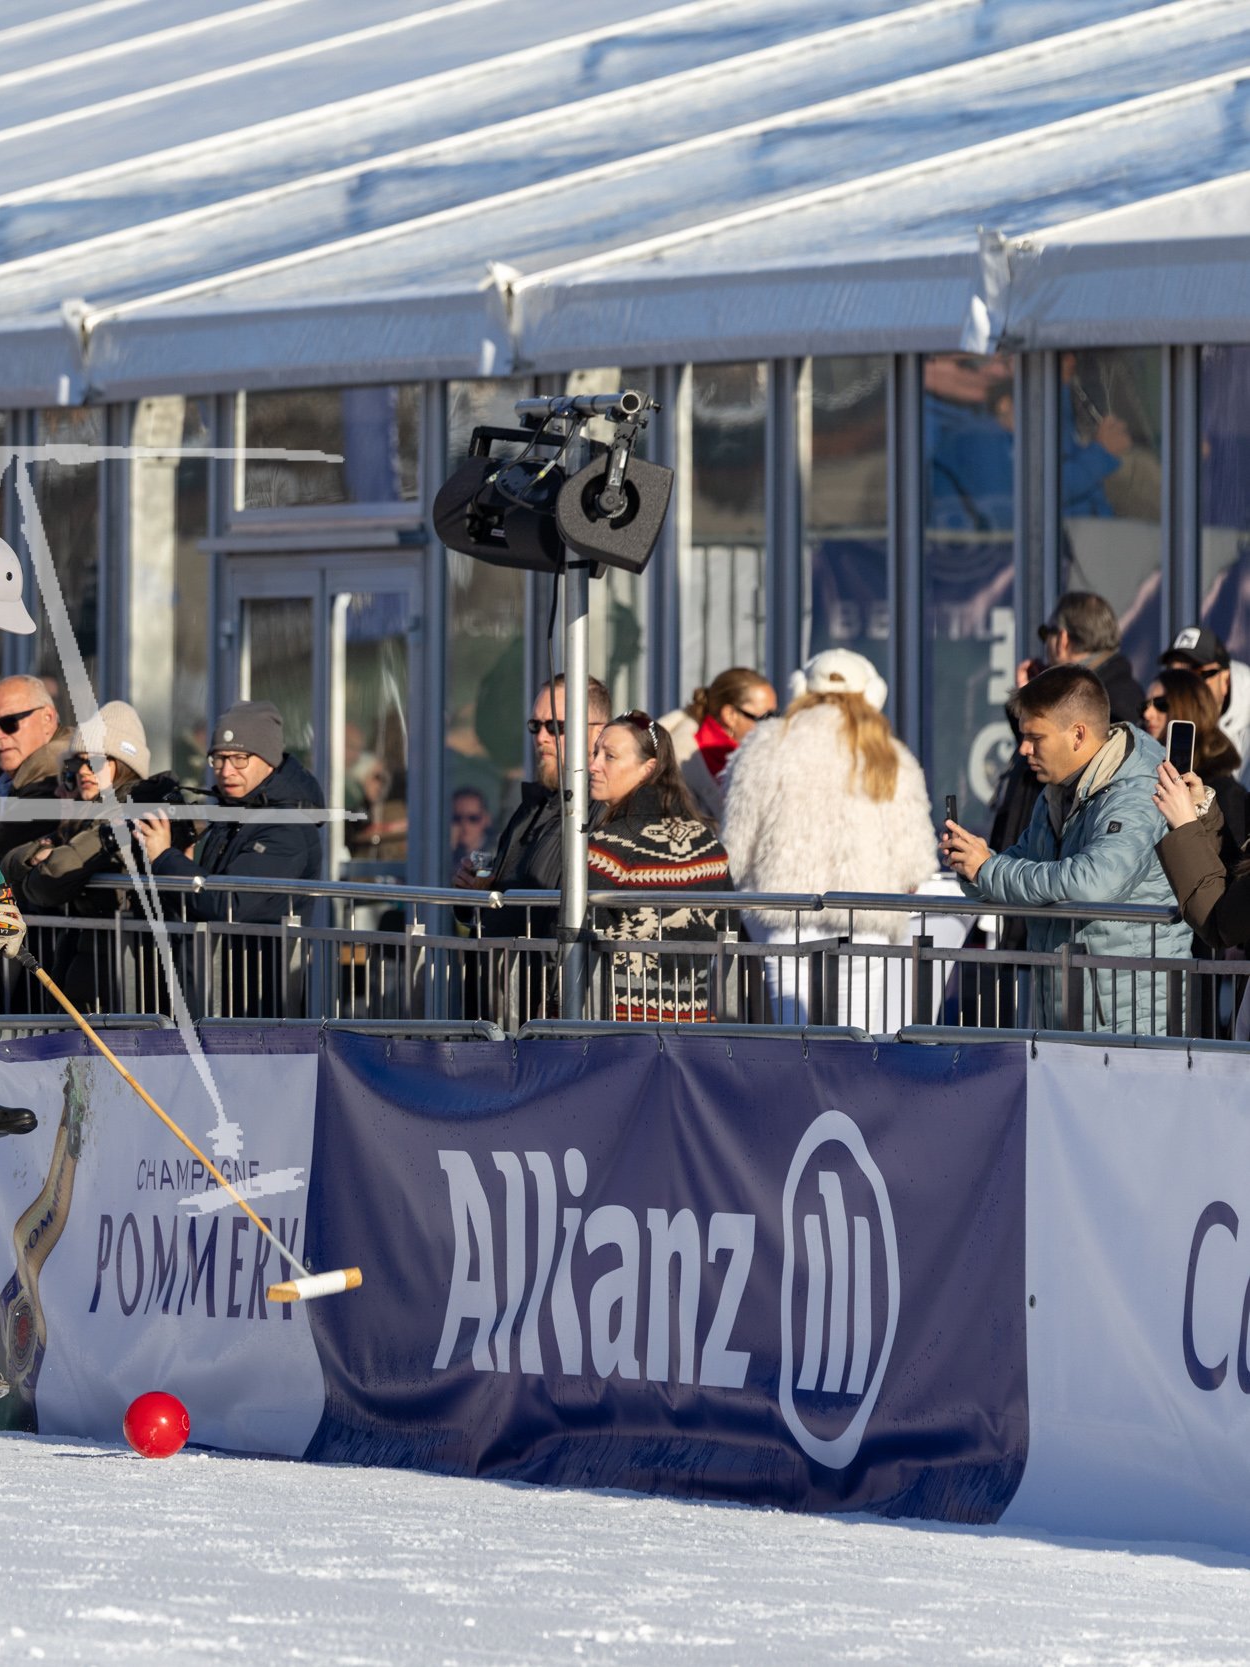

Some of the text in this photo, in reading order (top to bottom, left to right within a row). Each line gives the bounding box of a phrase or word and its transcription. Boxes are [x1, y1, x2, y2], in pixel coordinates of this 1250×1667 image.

[137, 1159, 261, 1191] CHAMPAGNE
[88, 1212, 299, 1320] POMMERY
[433, 1147, 755, 1389] Allianz
[1182, 1200, 1250, 1394] C
